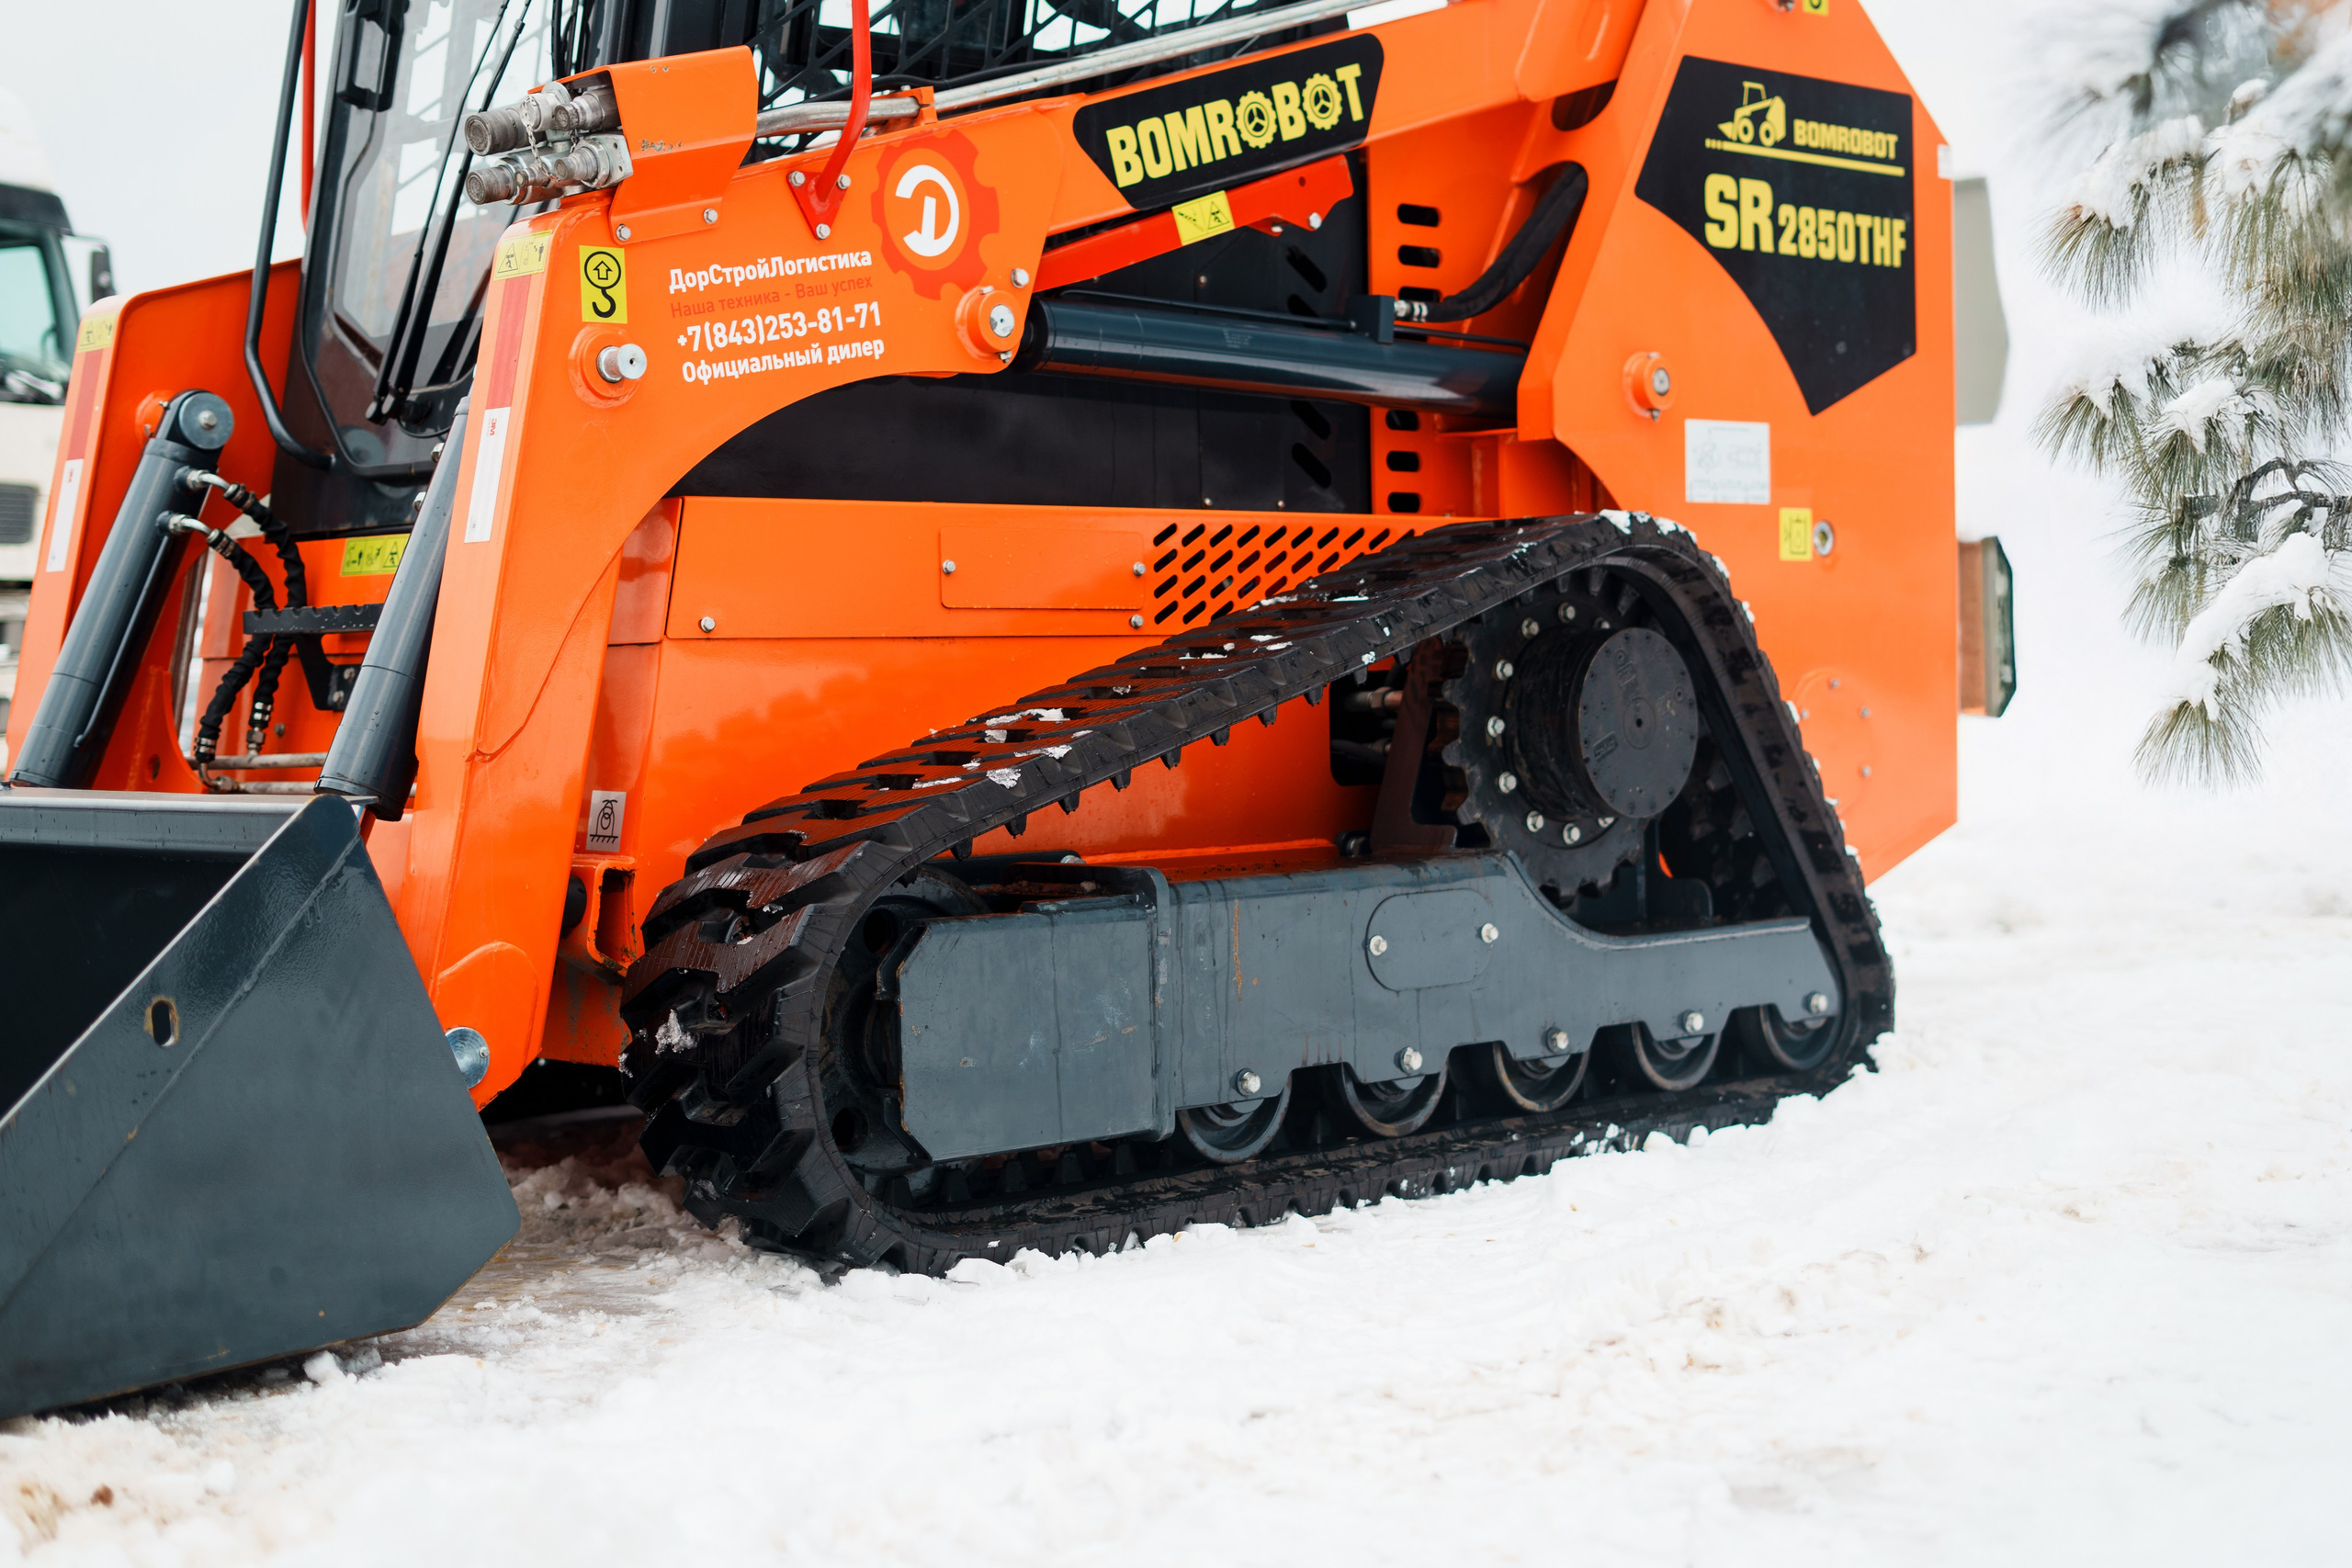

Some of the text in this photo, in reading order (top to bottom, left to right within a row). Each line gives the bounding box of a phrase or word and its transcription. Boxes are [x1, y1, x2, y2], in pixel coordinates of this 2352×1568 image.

[1106, 62, 1364, 188] BOMROBOT
[1793, 118, 1899, 160] BOMROBOT
[1704, 173, 1906, 268] SR 2850THF
[669, 250, 873, 294] ДорСтройЛогистика
[671, 300, 716, 319] Наша
[718, 291, 781, 311] техника
[795, 283, 828, 299] Ваш
[831, 276, 873, 297] успех
[677, 300, 881, 353] +7(843)253-81-71
[682, 338, 885, 386] Официальный дилер
